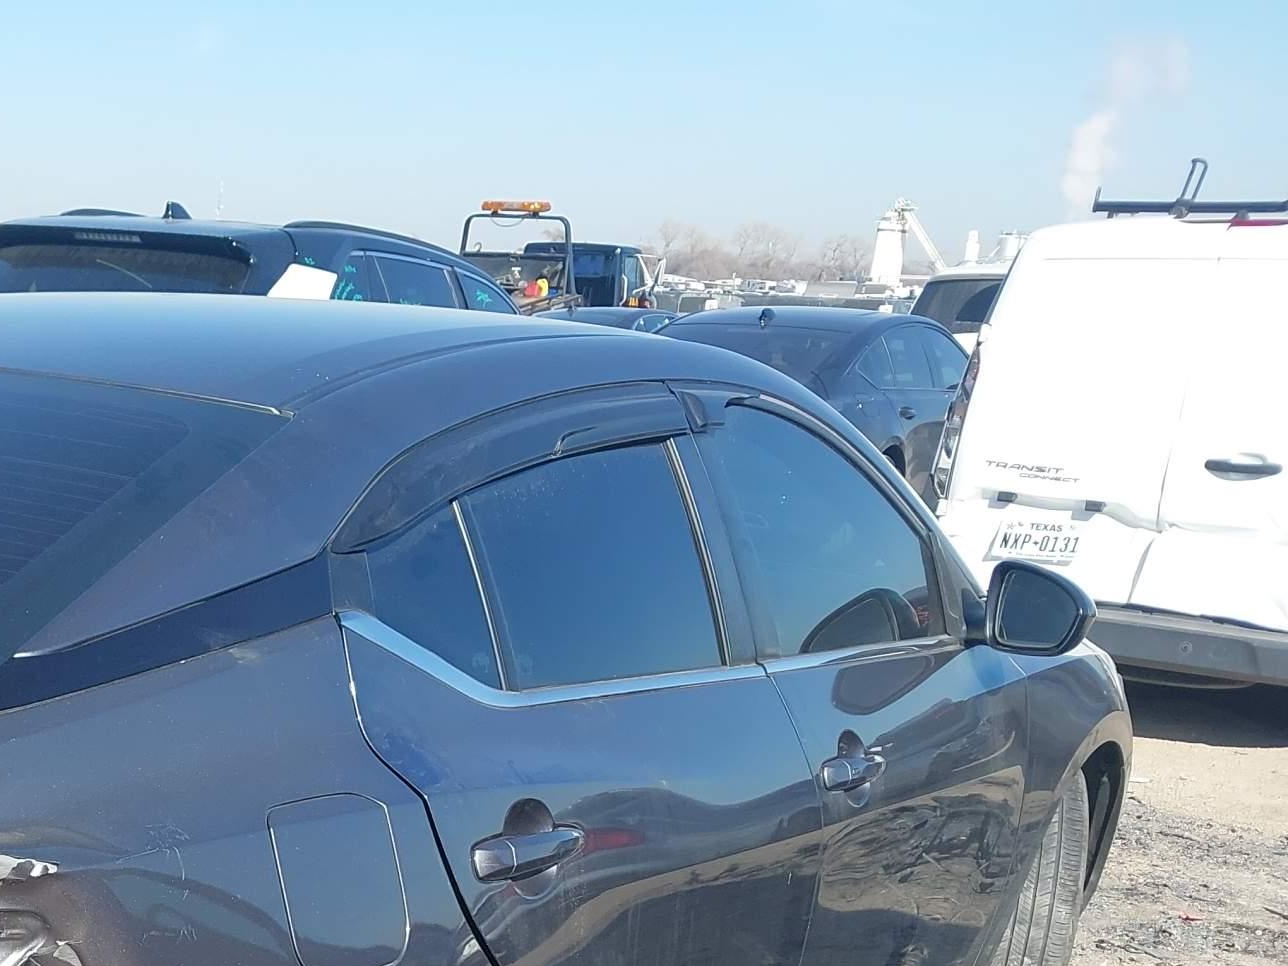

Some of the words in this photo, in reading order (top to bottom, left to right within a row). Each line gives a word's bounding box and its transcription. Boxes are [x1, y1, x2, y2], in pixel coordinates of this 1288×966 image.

[985, 460, 1065, 474] TRANSIT
[1019, 472, 1081, 483] CONNECT
[1029, 522, 1063, 532] TEXAS
